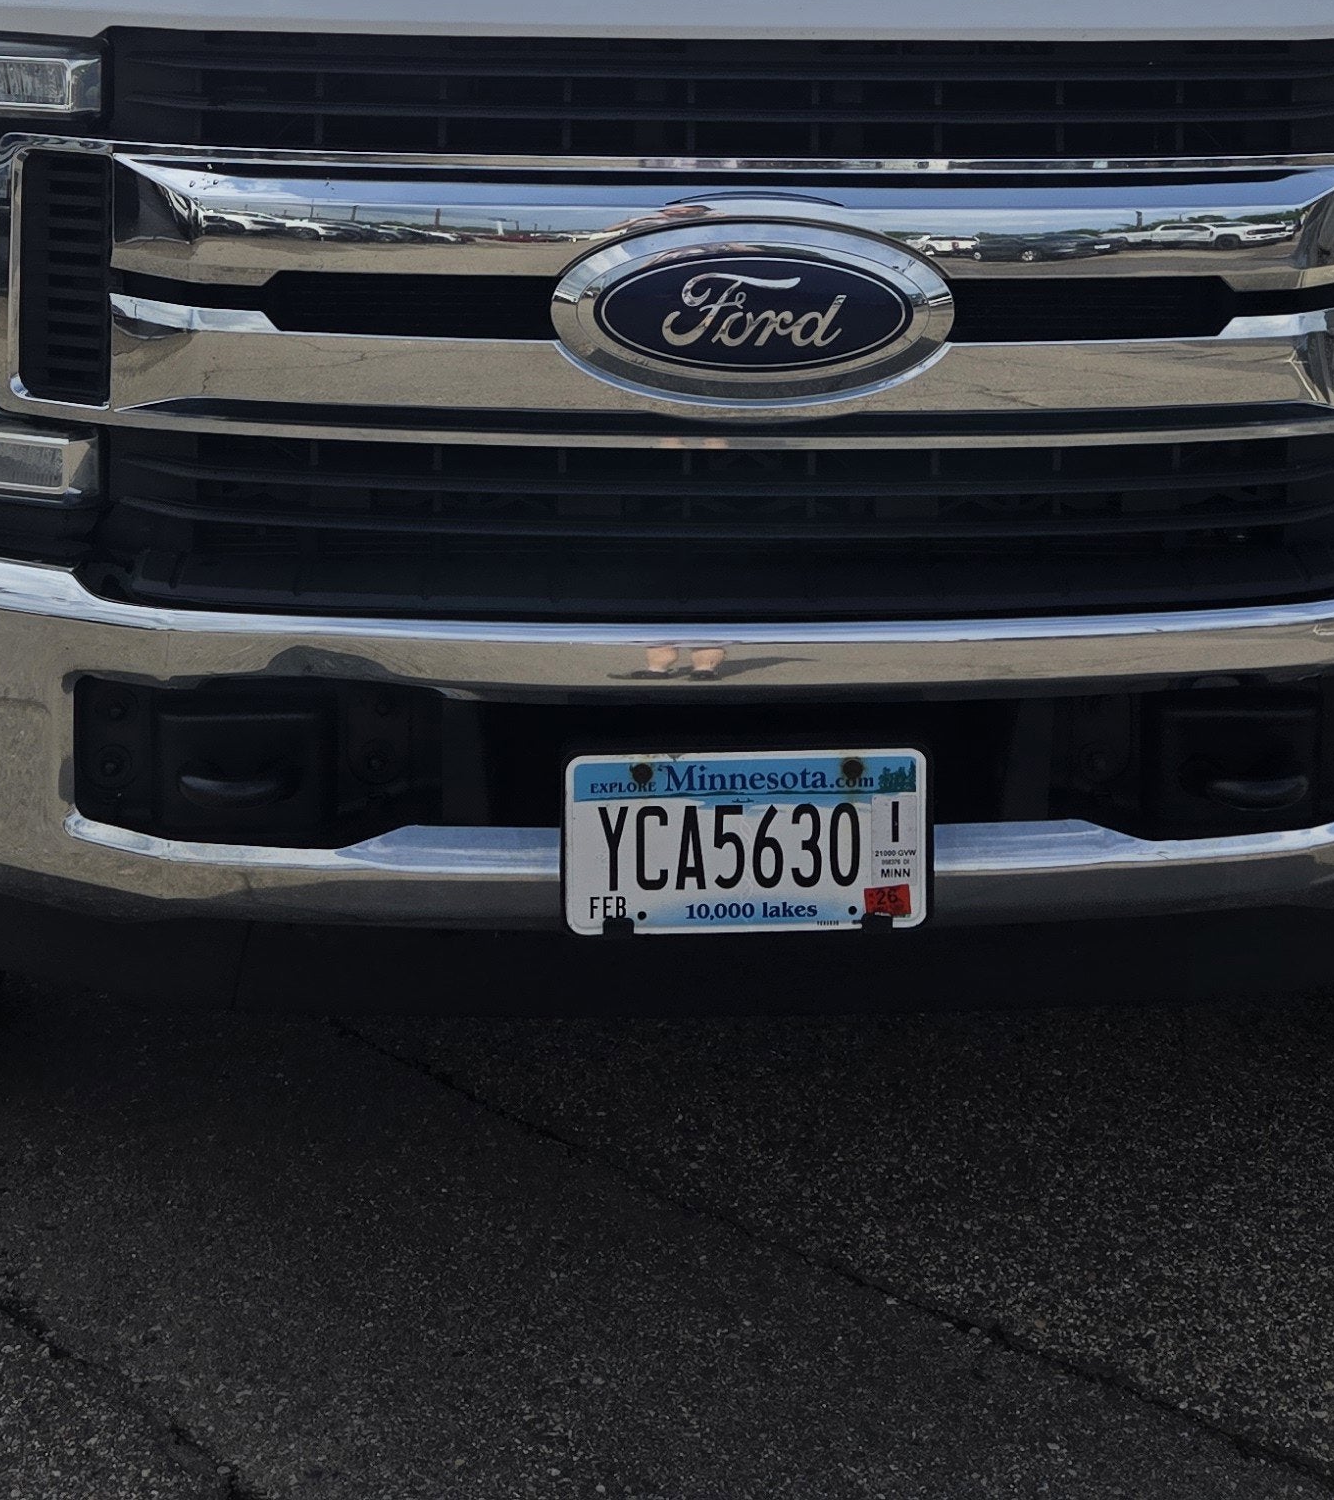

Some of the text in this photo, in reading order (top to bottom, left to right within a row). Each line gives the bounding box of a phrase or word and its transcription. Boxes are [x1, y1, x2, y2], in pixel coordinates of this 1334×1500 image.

[662, 272, 847, 348] Ford
[590, 780, 656, 794] EXPLORE
[598, 802, 861, 891] YCA5630
[898, 848, 917, 857] GVW
[881, 868, 911, 879] MINN
[590, 896, 627, 919] FEB
[685, 901, 818, 921] 10,000 lakes
